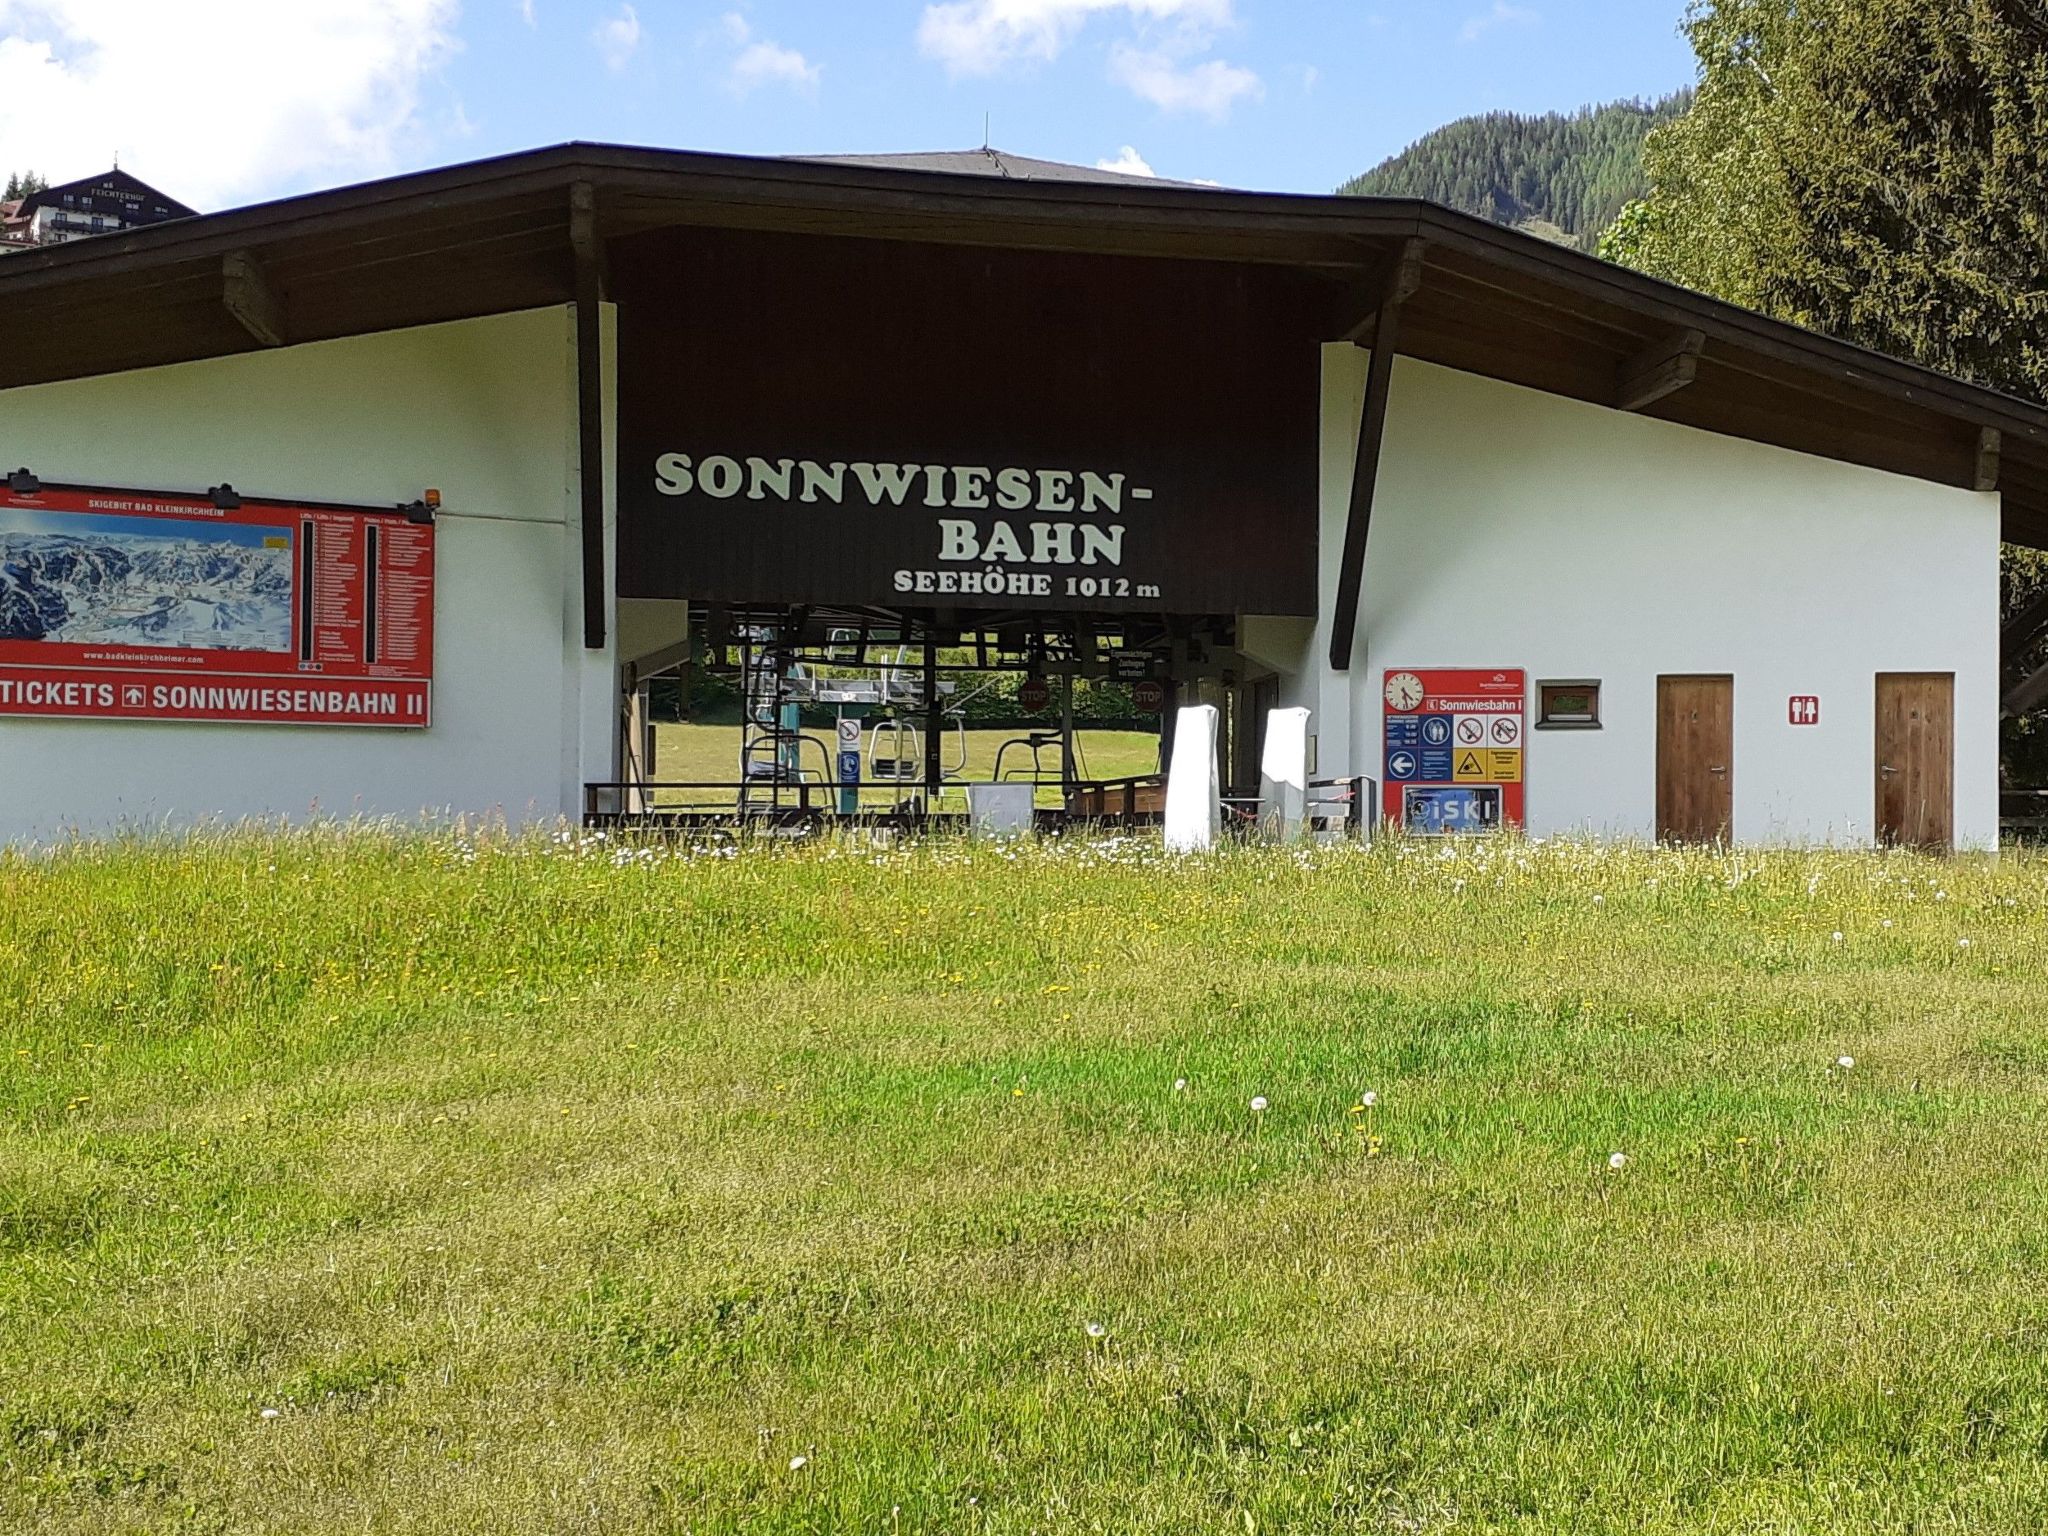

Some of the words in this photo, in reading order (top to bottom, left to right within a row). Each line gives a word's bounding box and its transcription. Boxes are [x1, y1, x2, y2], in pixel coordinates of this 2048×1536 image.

[655, 452, 1153, 514] SONNWIESEN-
[88, 499, 132, 511] SKIGEBIET
[134, 503, 152, 512] BAD
[154, 504, 225, 517] KLEINKIRCHHEIM
[937, 518, 1126, 565] BAHN
[893, 565, 1052, 596] SEEHÖHE
[1065, 577, 1130, 597] 1012
[1135, 585, 1161, 598] m
[0, 680, 114, 707] TICKETS
[152, 685, 397, 715] SONNWIESENBAHN
[407, 694, 423, 715] II
[1020, 689, 1047, 702] STOP
[1135, 691, 1161, 703] STOP
[1439, 699, 1516, 711] Sonnwiesbahn
